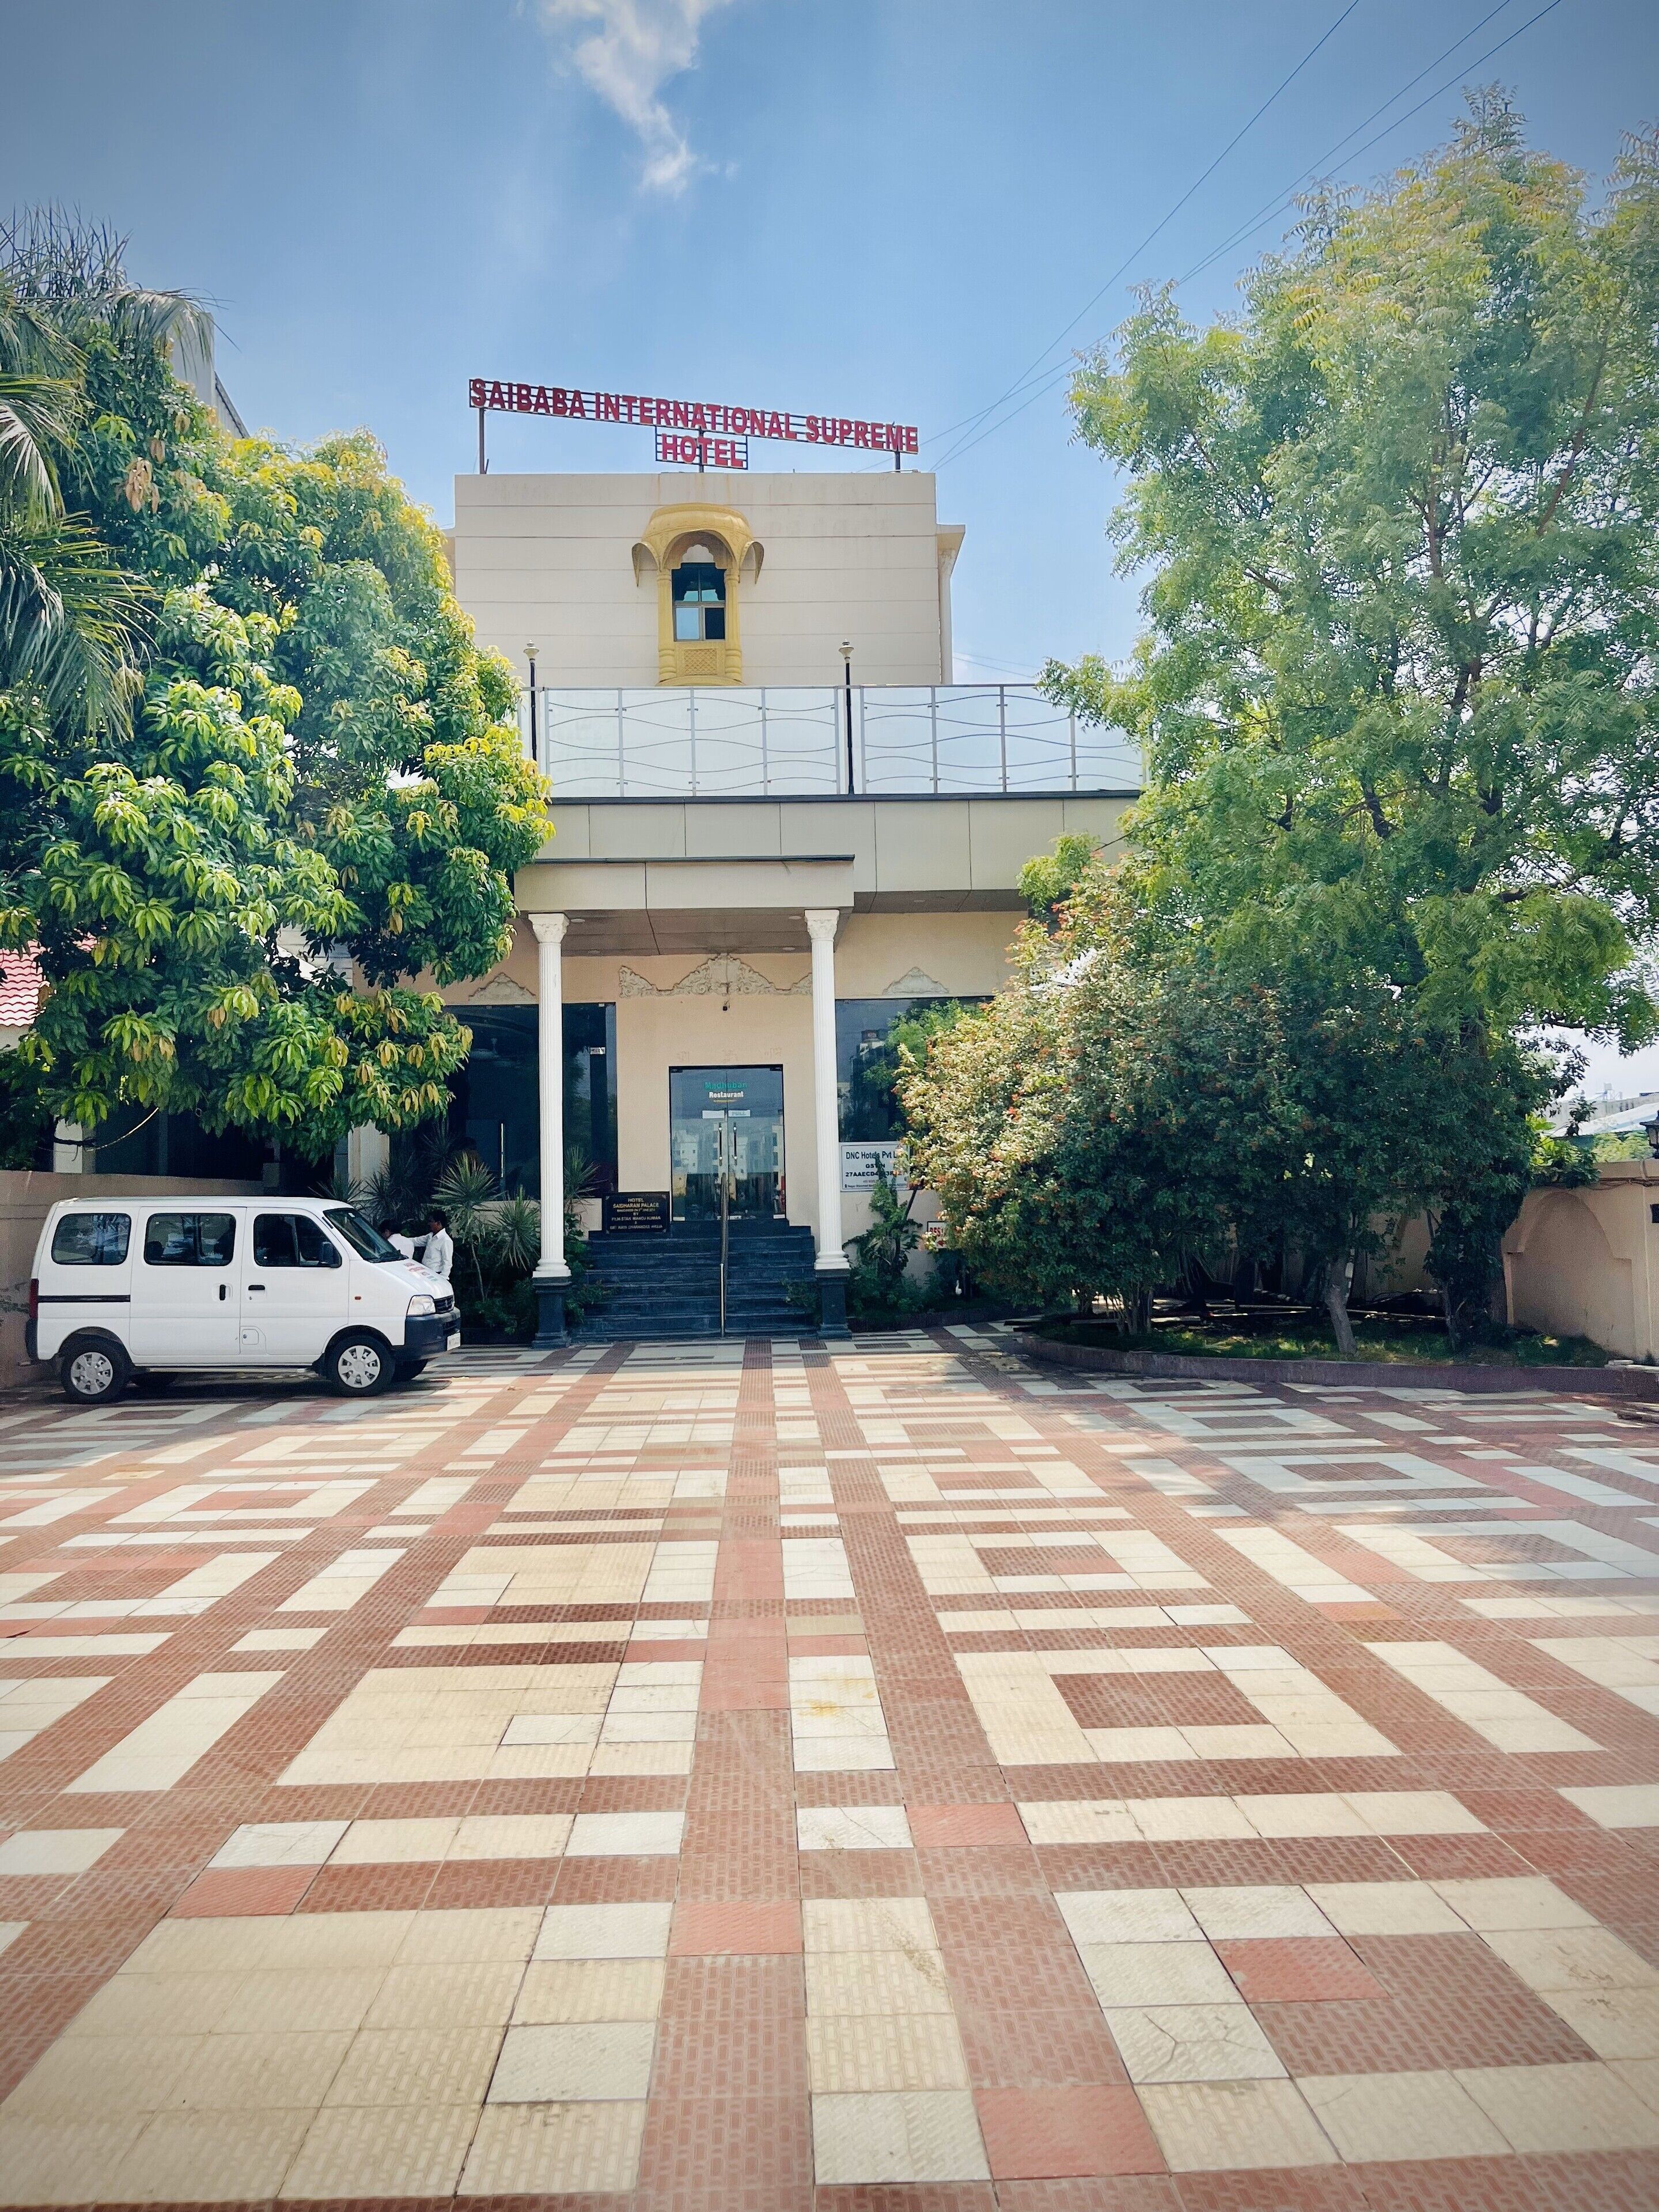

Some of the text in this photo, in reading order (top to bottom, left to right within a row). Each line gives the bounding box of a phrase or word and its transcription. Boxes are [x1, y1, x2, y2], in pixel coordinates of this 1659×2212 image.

[471, 378, 918, 454] SAIBABA INTERNATIONAL SUPREME
[662, 433, 744, 468] HOTEL
[882, 1150, 892, 1158] Pvt
